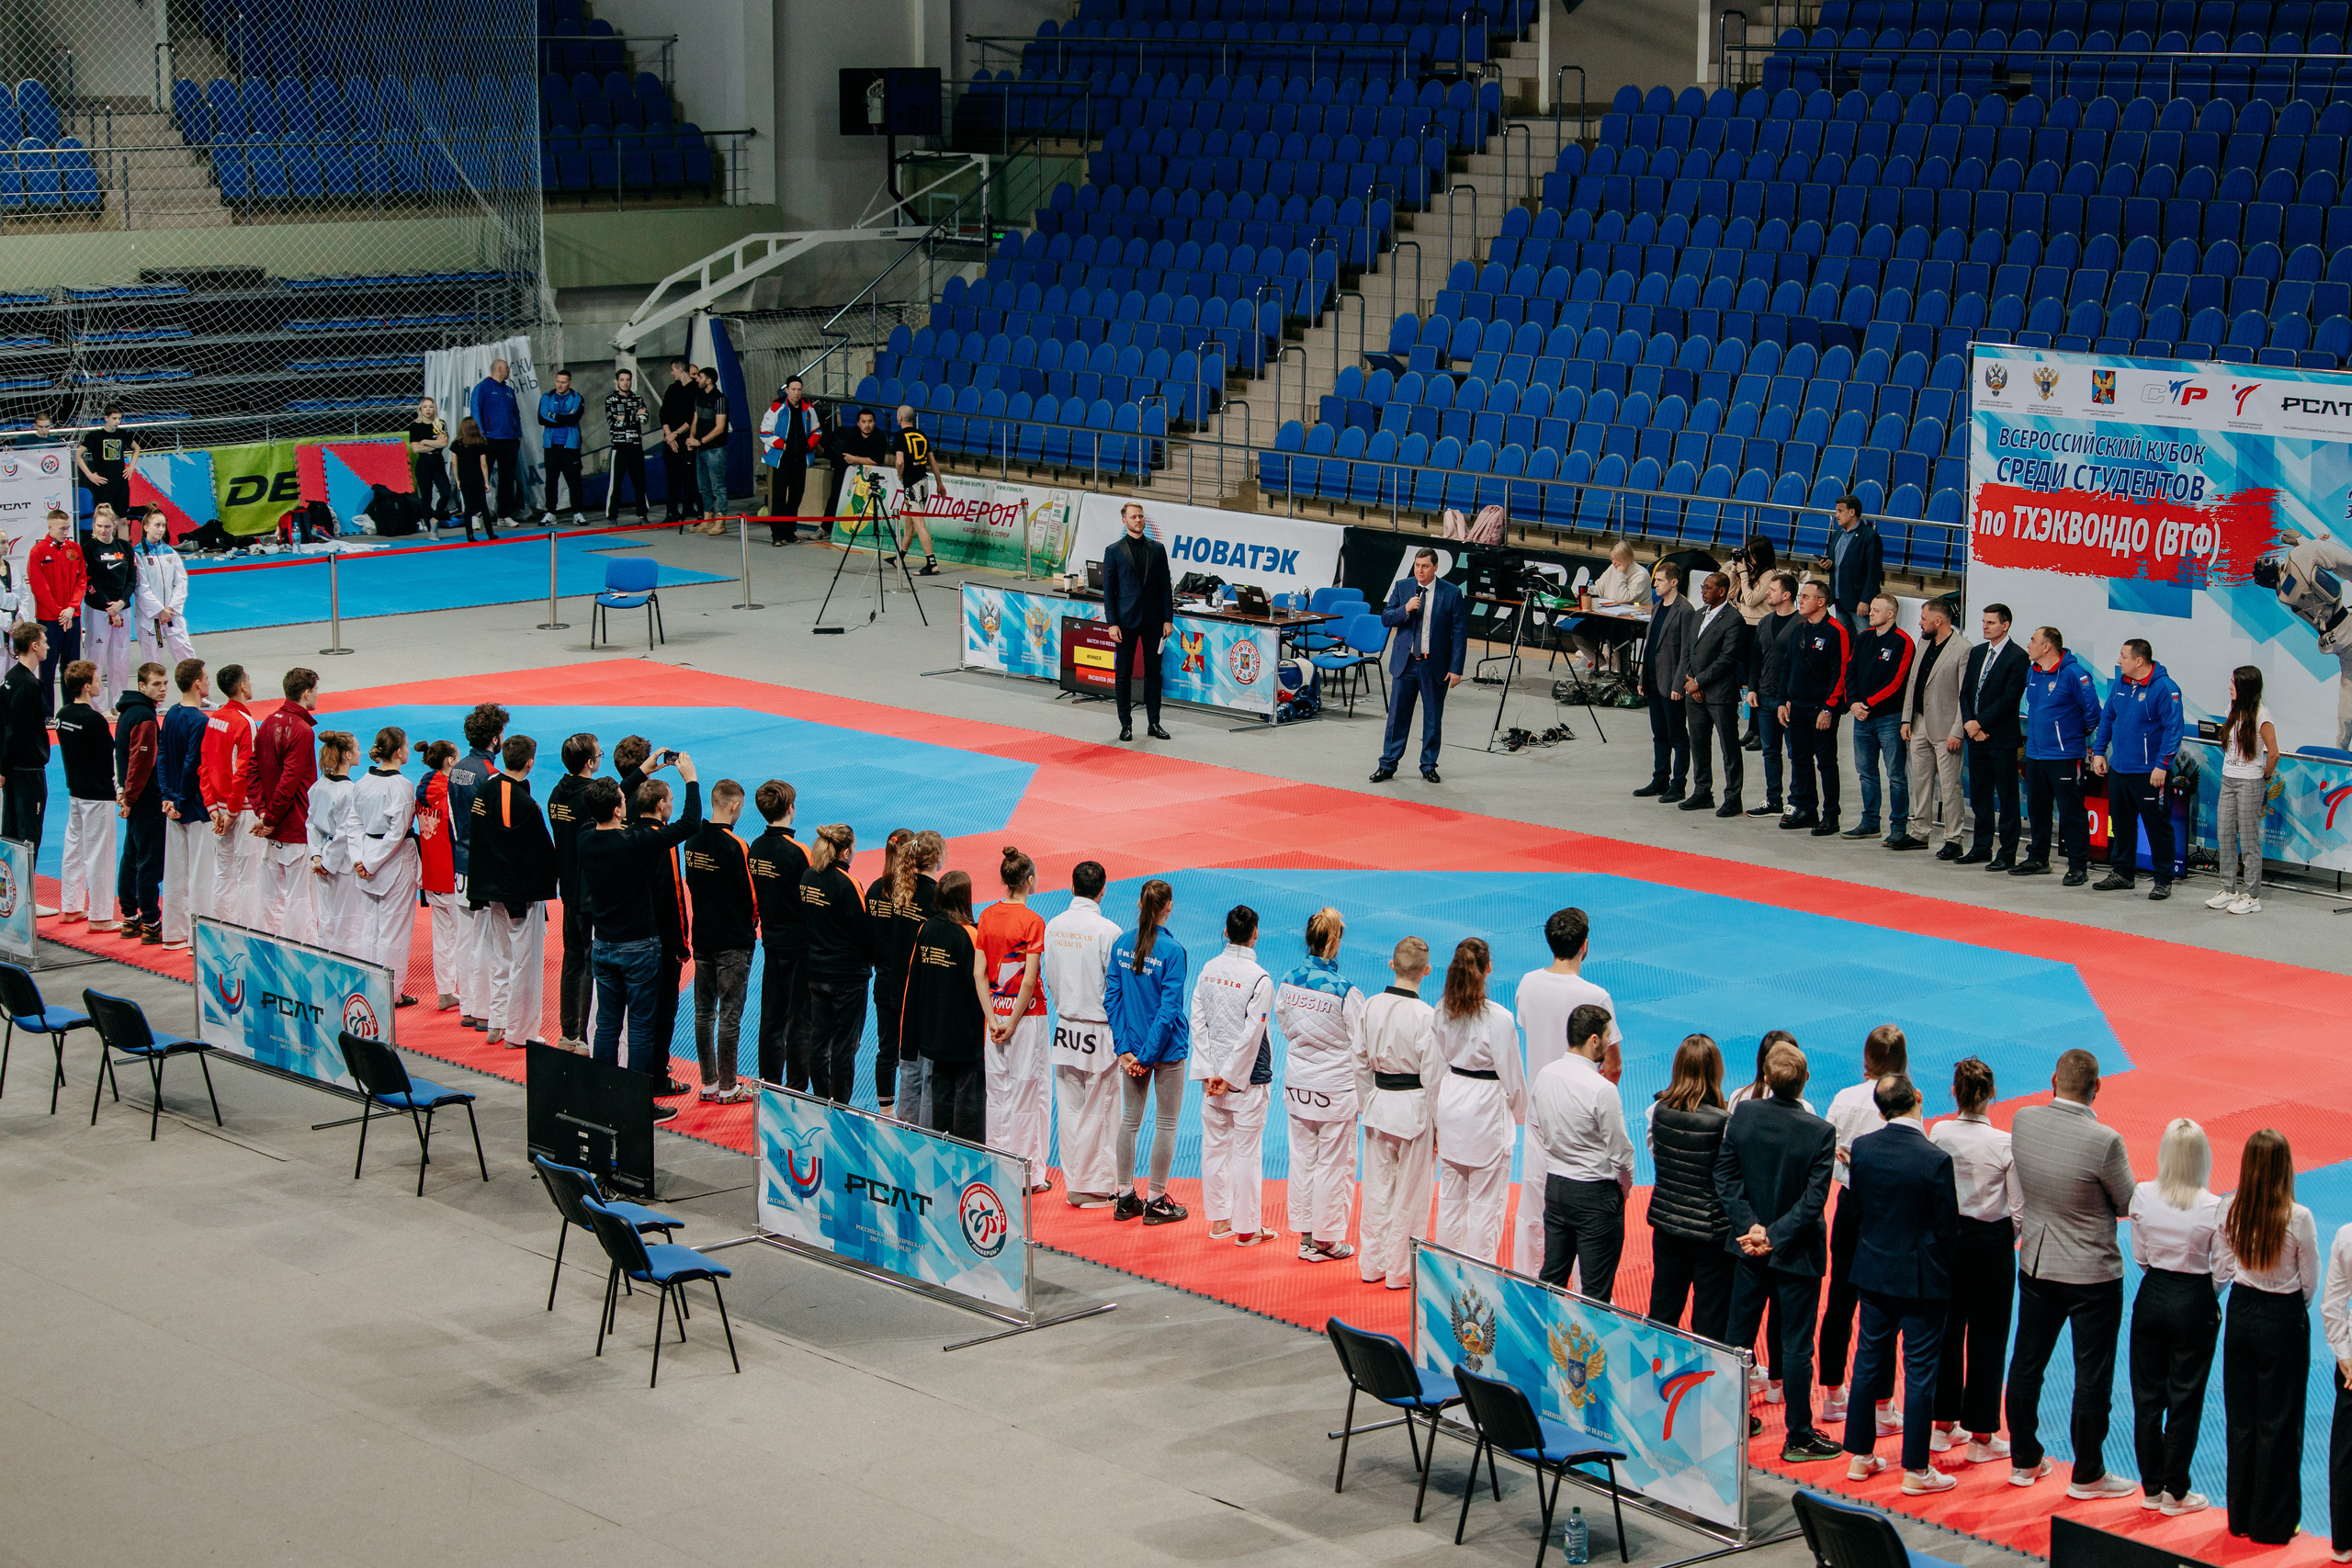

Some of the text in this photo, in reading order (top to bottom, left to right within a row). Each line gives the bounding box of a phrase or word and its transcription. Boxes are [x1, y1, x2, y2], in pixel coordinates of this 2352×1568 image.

[1998, 427, 2207, 466] ВСЕРОССИЙСКИЙ КУБОК
[1996, 457, 2206, 502] СРЕДИ СТУДЕНТОВ
[1979, 505, 2222, 568] по ТХЭКВОНДО (ВТФ)
[1170, 535, 1301, 576] НОВАТЭК
[1049, 931, 1092, 942] МОСКОВСКАЯ
[1054, 940, 1083, 949] ОБЛАСТЬ
[1204, 976, 1241, 989] RUSSIA
[260, 990, 324, 1025] РСЛТ
[1052, 1026, 1097, 1055] RUS
[844, 1172, 933, 1216] РСЛТ
[971, 1243, 998, 1257] ЛЮБЕРЦЫ
[1591, 1427, 1613, 1441] НАУКИ
